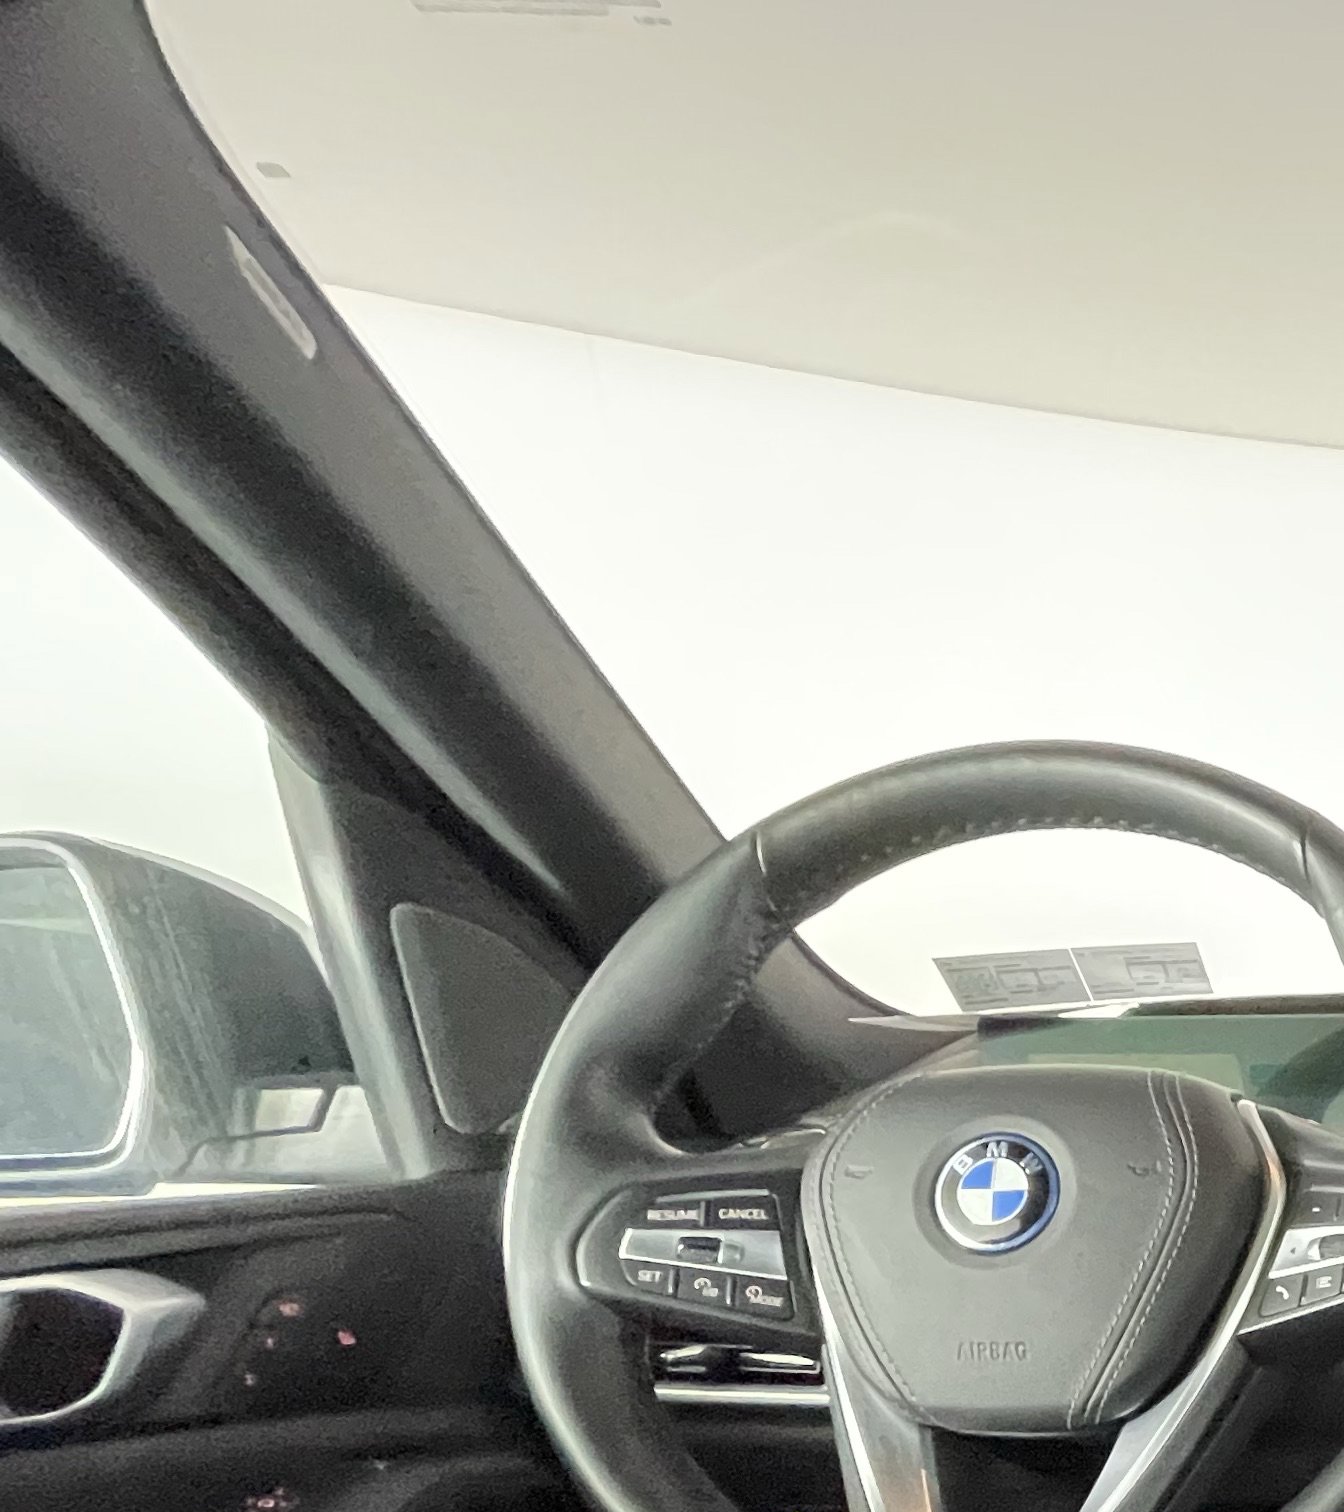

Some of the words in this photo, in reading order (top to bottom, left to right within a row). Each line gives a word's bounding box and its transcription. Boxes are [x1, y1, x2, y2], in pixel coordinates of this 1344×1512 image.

[953, 1141, 1044, 1176] BMW
[718, 1208, 770, 1221] CANCEL
[637, 1269, 662, 1282] SET
[956, 1341, 1028, 1362] AIRBAG
